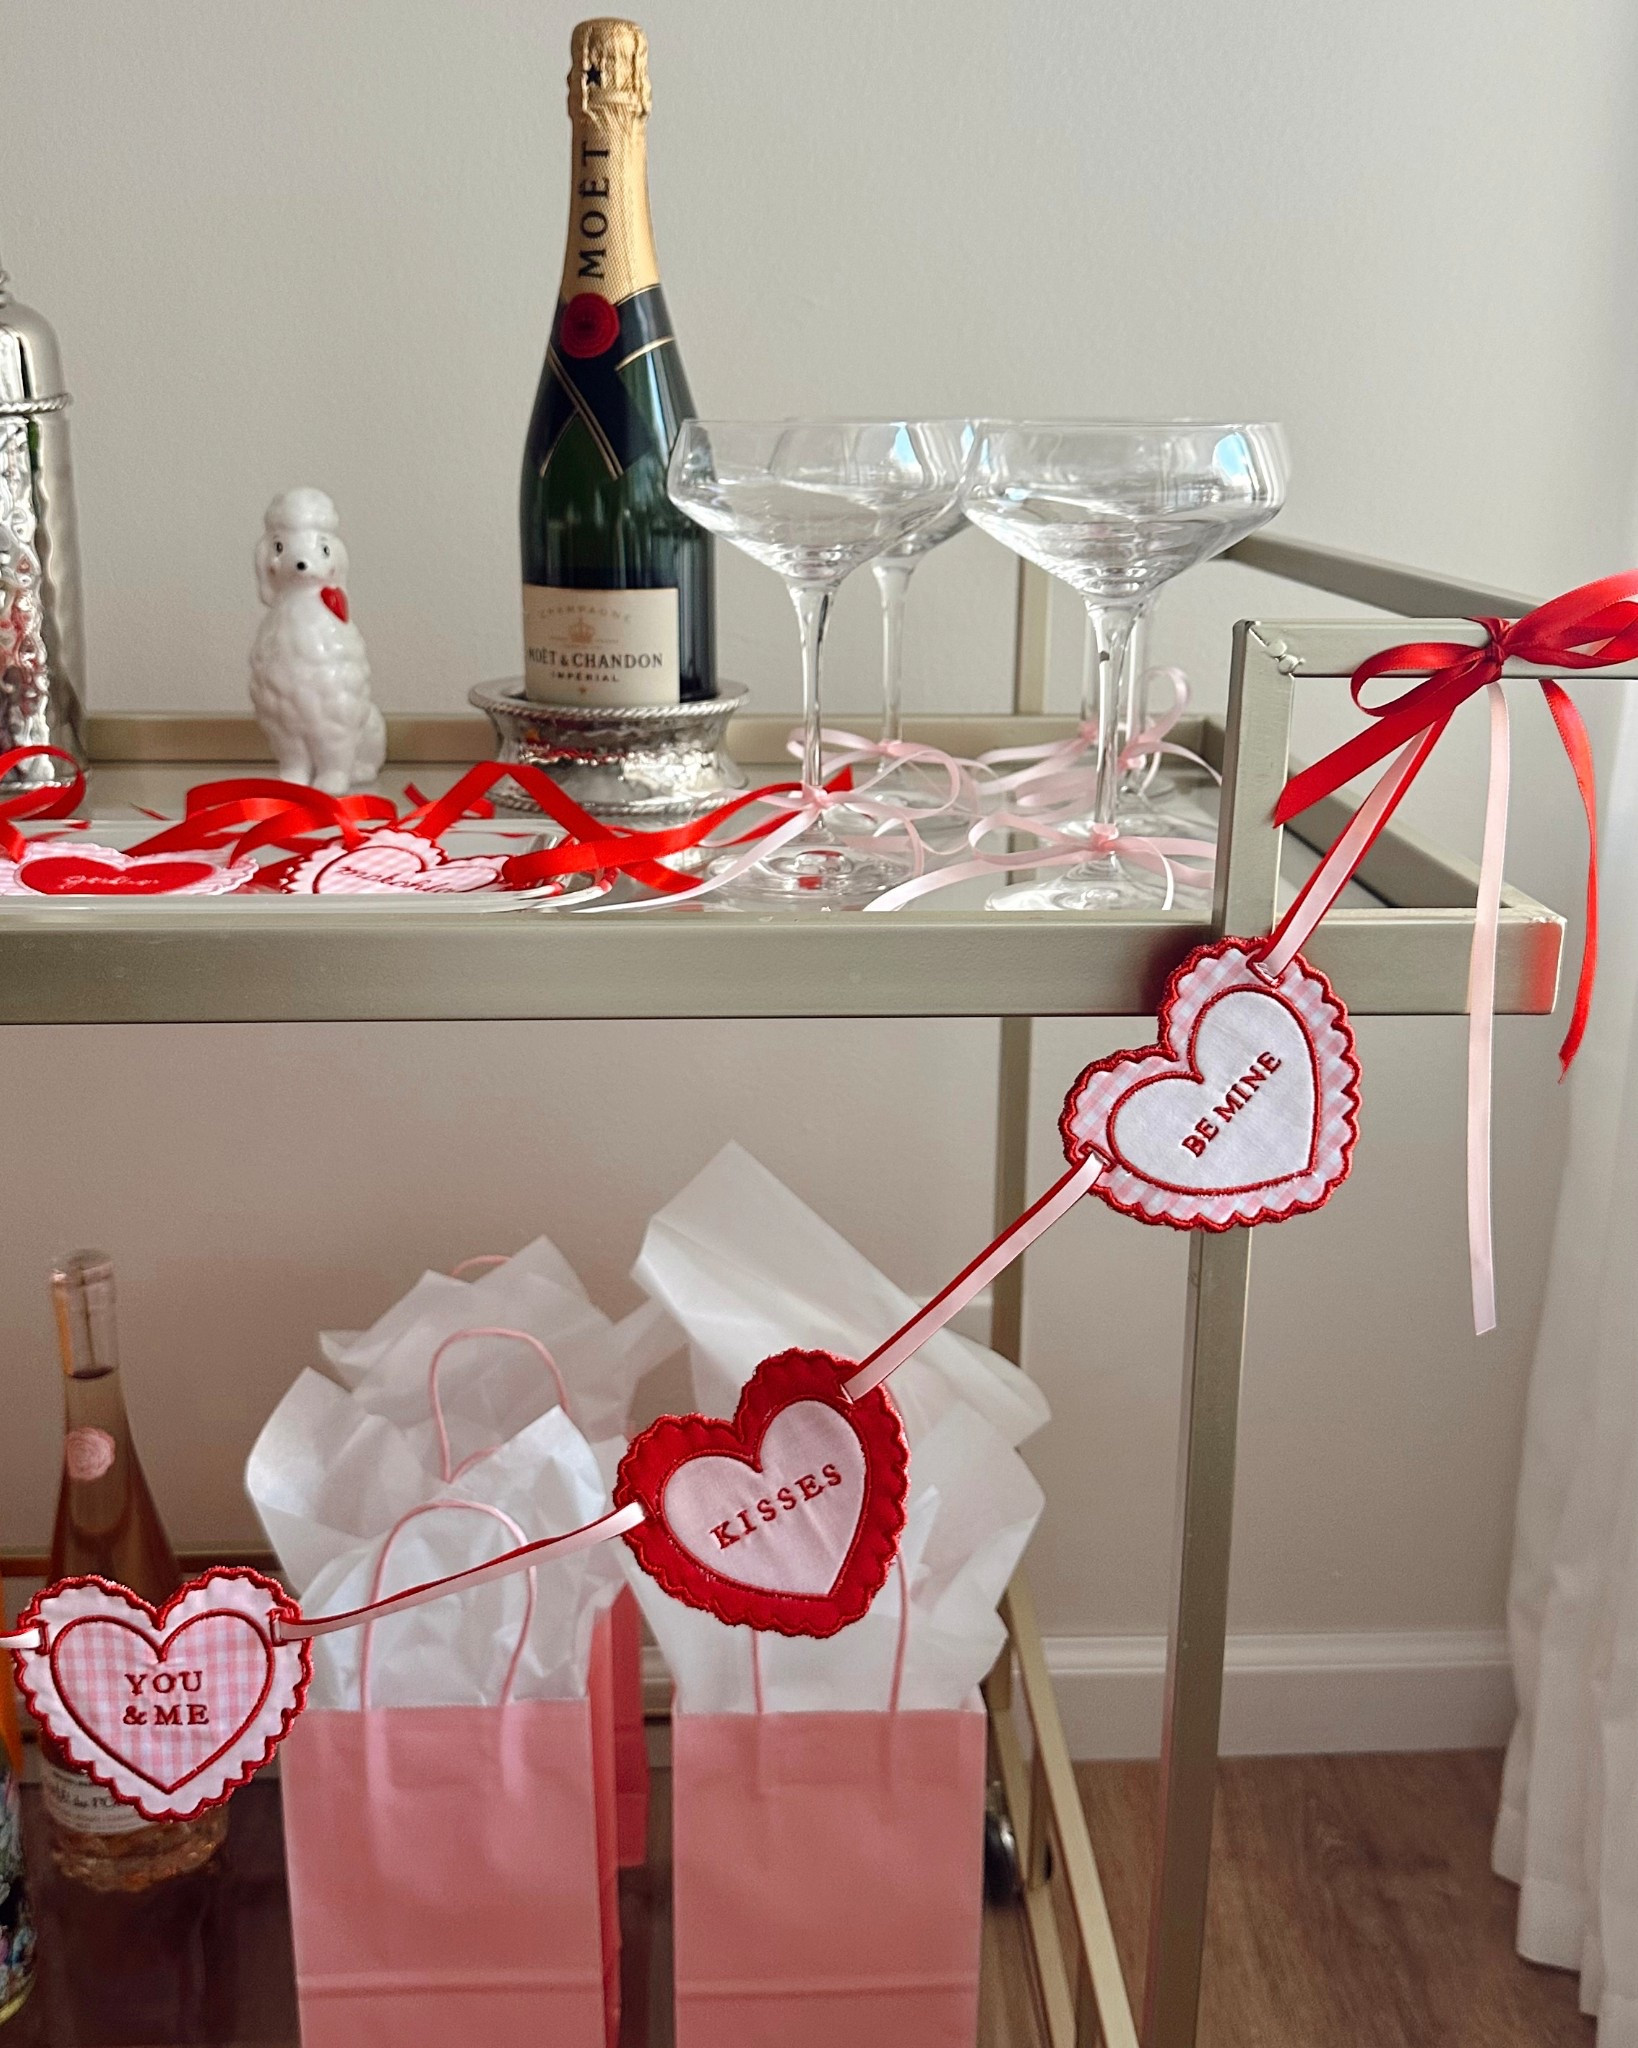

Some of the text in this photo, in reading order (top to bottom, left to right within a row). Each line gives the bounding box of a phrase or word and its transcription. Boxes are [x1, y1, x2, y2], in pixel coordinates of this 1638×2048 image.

[560, 655, 570, 667] &
[572, 652, 664, 669] CHANDON
[1181, 1051, 1282, 1158] BE MINE
[710, 1463, 842, 1549] KISSES
[124, 1670, 204, 1696] YOU
